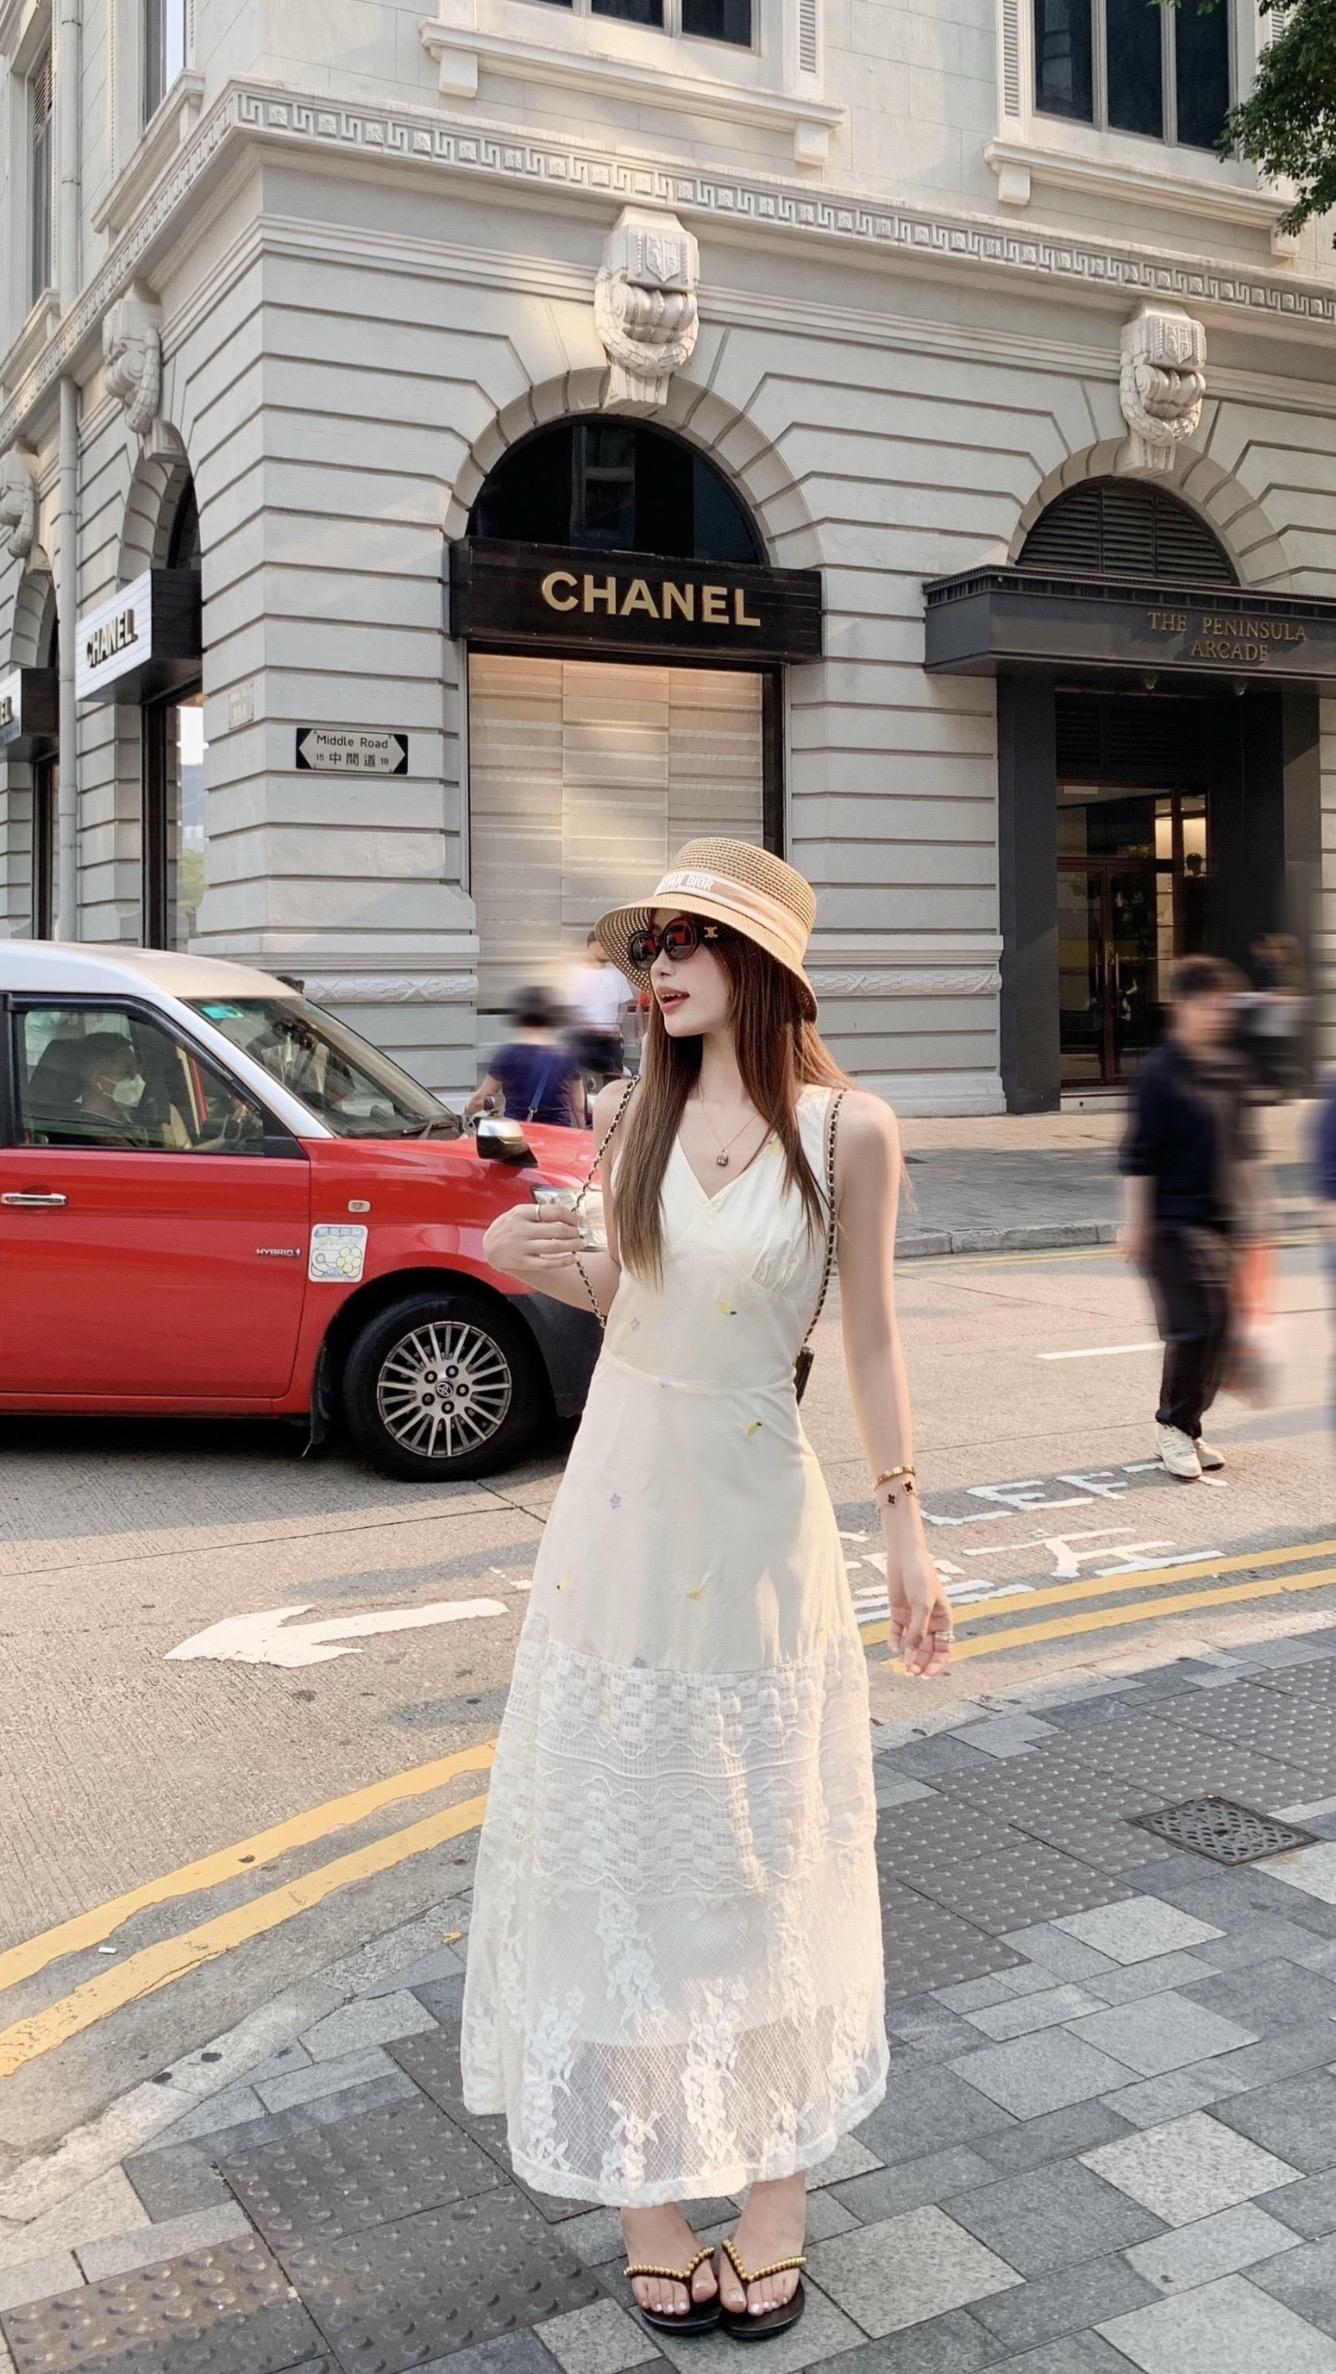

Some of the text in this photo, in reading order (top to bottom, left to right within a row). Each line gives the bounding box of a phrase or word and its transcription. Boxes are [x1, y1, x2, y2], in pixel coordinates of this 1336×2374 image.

[541, 570, 761, 627] CHANEL
[1147, 612, 1309, 642] THE PENINSULA
[86, 608, 139, 668] CHANEL
[1191, 639, 1270, 662] ARCADE
[316, 735, 389, 750] Middle Road
[329, 751, 376, 768] 中間道
[687, 873, 714, 891] DIOR
[256, 1247, 294, 1257] HYBRID
